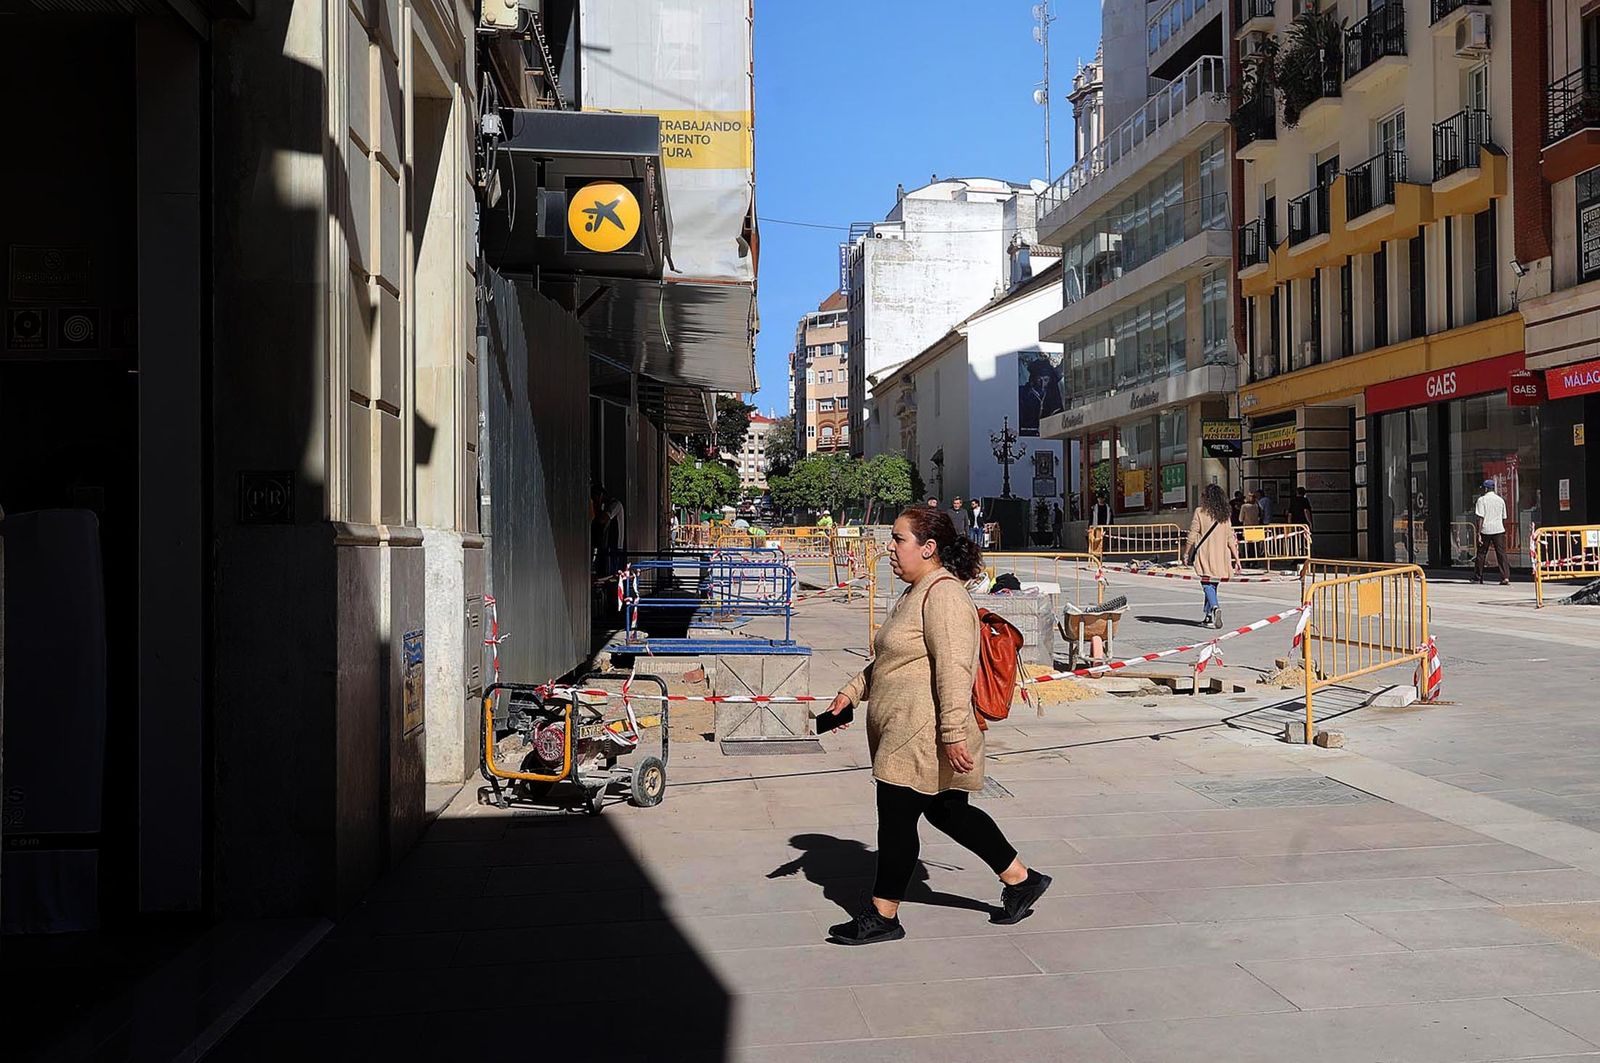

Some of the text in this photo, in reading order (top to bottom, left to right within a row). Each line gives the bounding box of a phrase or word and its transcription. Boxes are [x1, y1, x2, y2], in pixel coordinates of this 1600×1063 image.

[659, 120, 741, 132] TRABAJANDO
[1426, 371, 1457, 398] GAES
[1512, 384, 1537, 394] GAES
